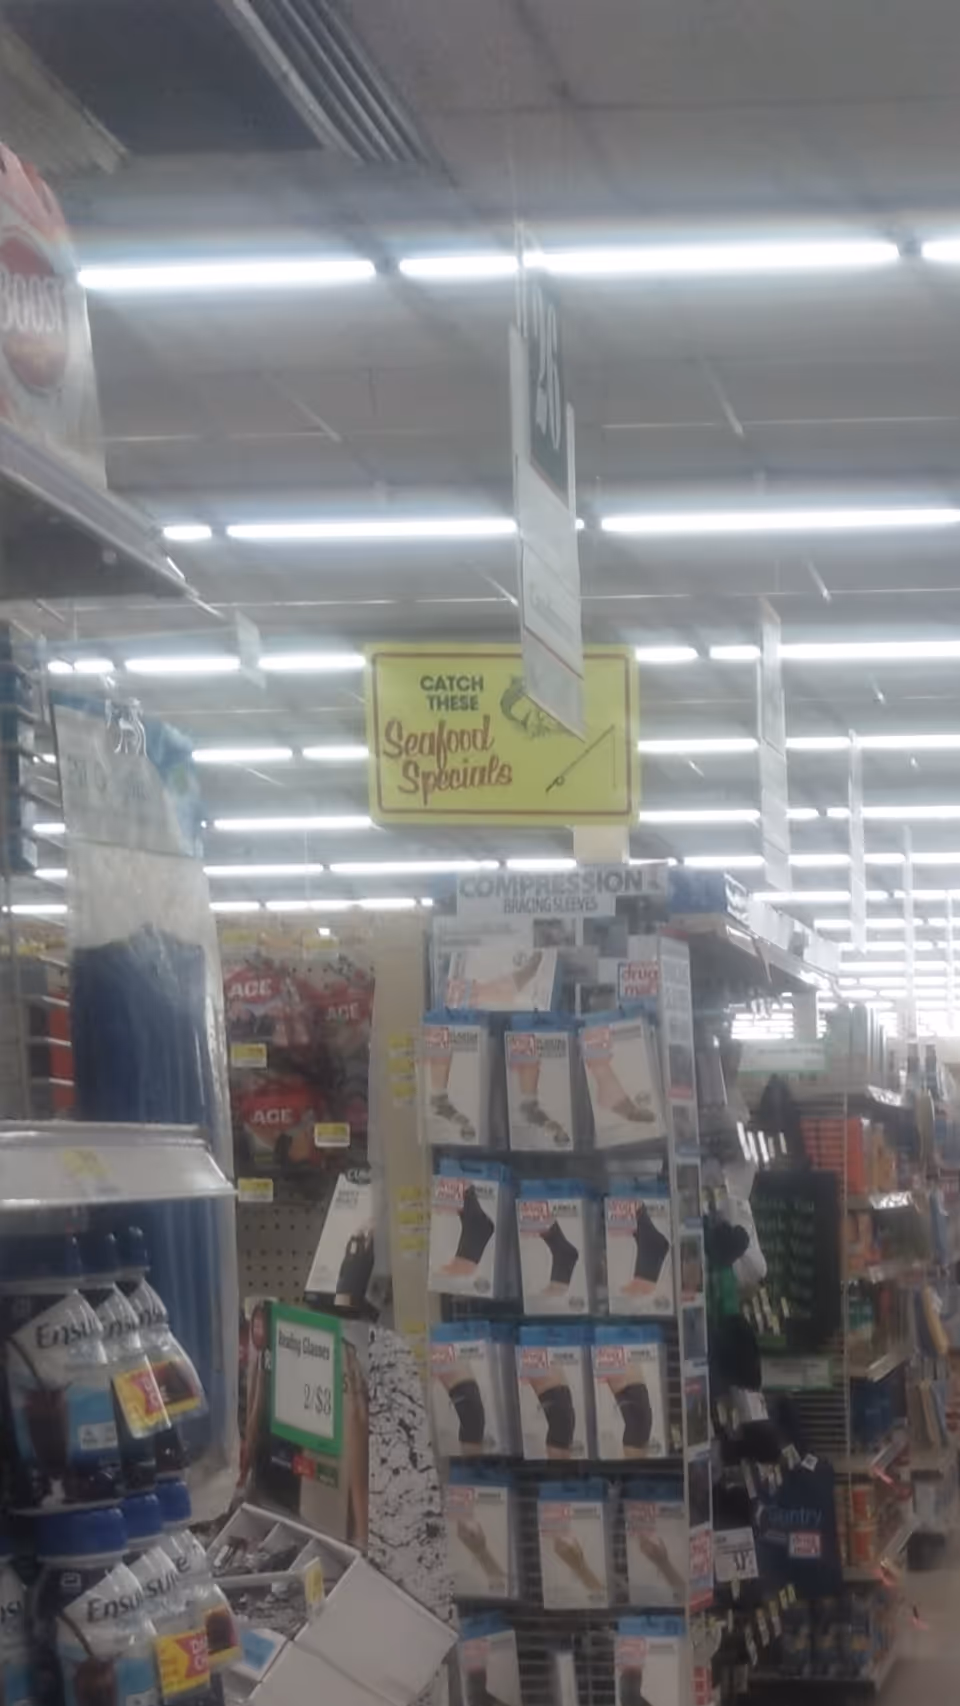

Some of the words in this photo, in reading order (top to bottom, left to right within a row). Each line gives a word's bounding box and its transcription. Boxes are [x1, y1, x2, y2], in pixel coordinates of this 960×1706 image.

[419, 676, 484, 692] CATCH
[426, 694, 479, 711] THESE
[383, 714, 494, 769] Seafood
[398, 754, 512, 806] Specials
[459, 869, 644, 897] COMPRESSION
[251, 1109, 293, 1125] ACE
